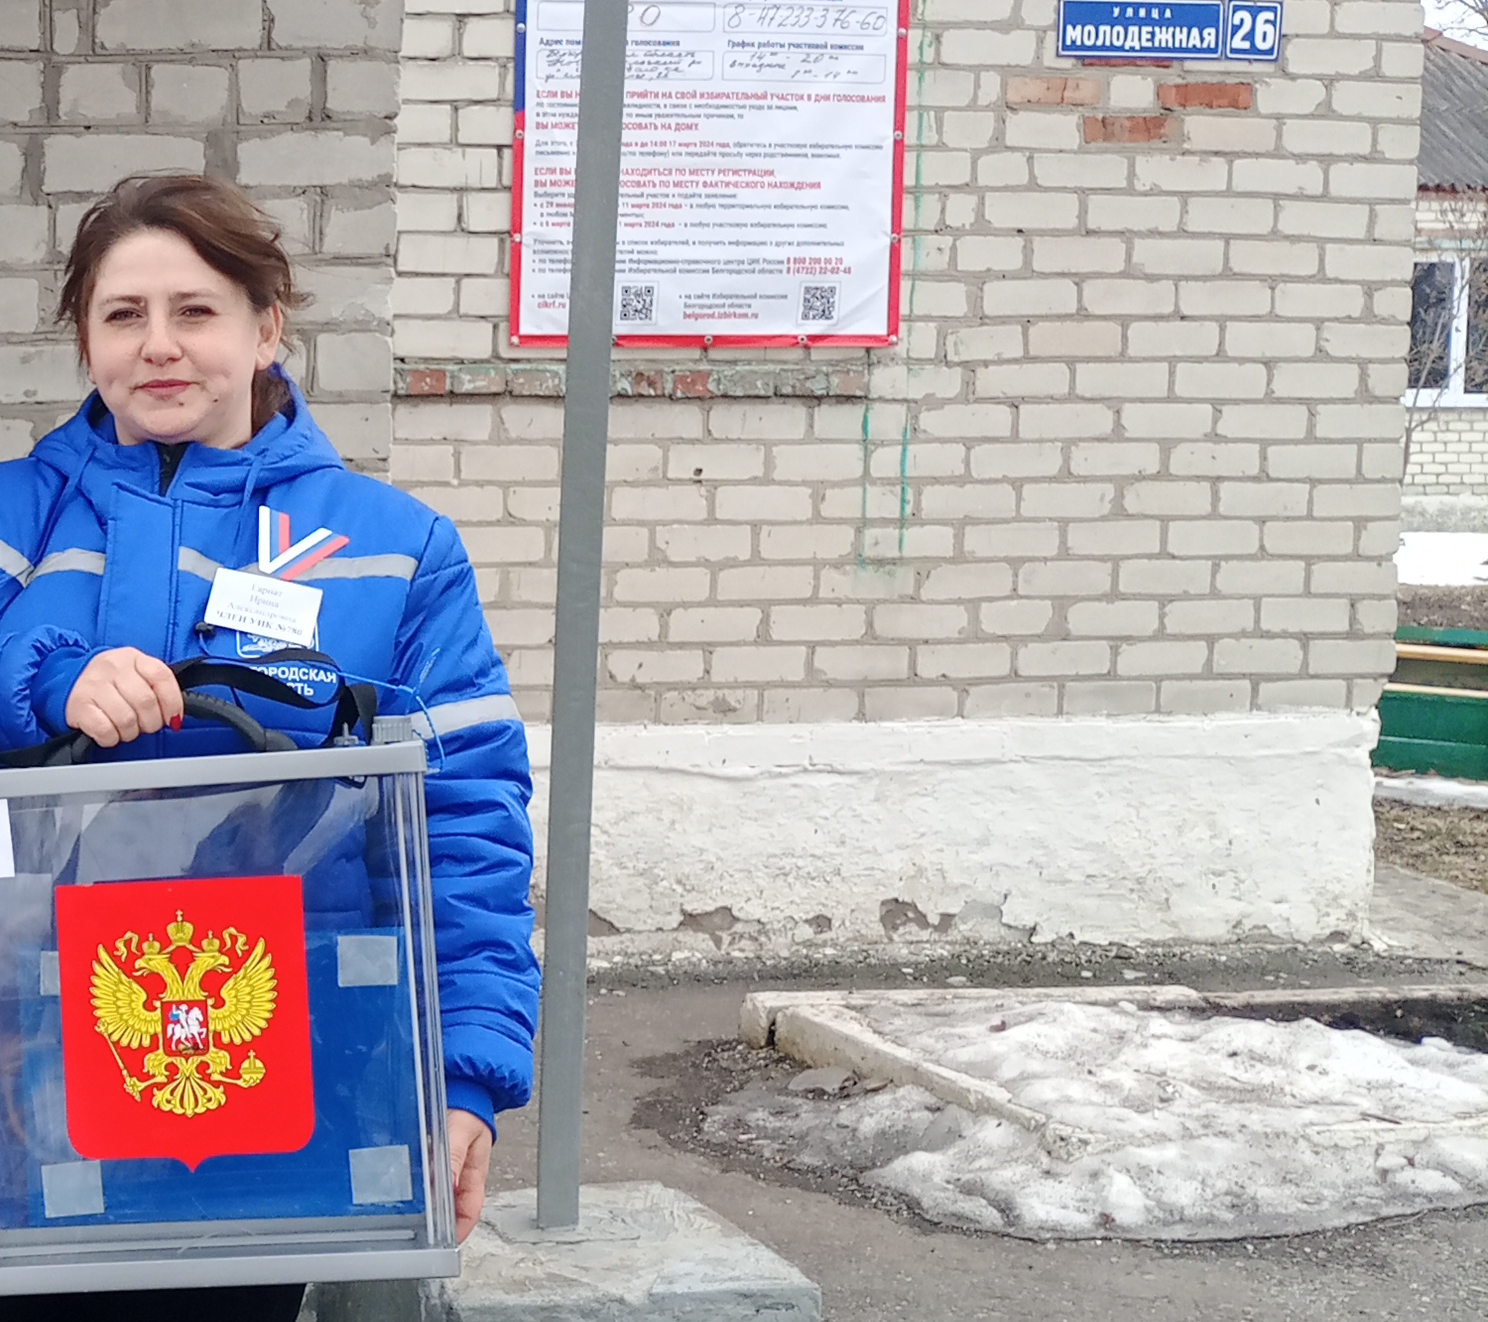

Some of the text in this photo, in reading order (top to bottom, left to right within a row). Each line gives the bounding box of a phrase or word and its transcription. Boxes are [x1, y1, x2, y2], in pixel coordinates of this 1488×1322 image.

[1112, 6, 1172, 20] УЛИЦА
[1065, 10, 1275, 51] МОЛОДЕЖНАЯ 26
[661, 90, 673, 100] НА
[550, 121, 577, 131] МОЖЕ
[621, 121, 659, 131] ОСОВАТЬ
[549, 179, 576, 188] МОЖЕ
[620, 180, 658, 189] ОСОВАТЬ
[250, 666, 337, 683] ОРОДСКАЯ
